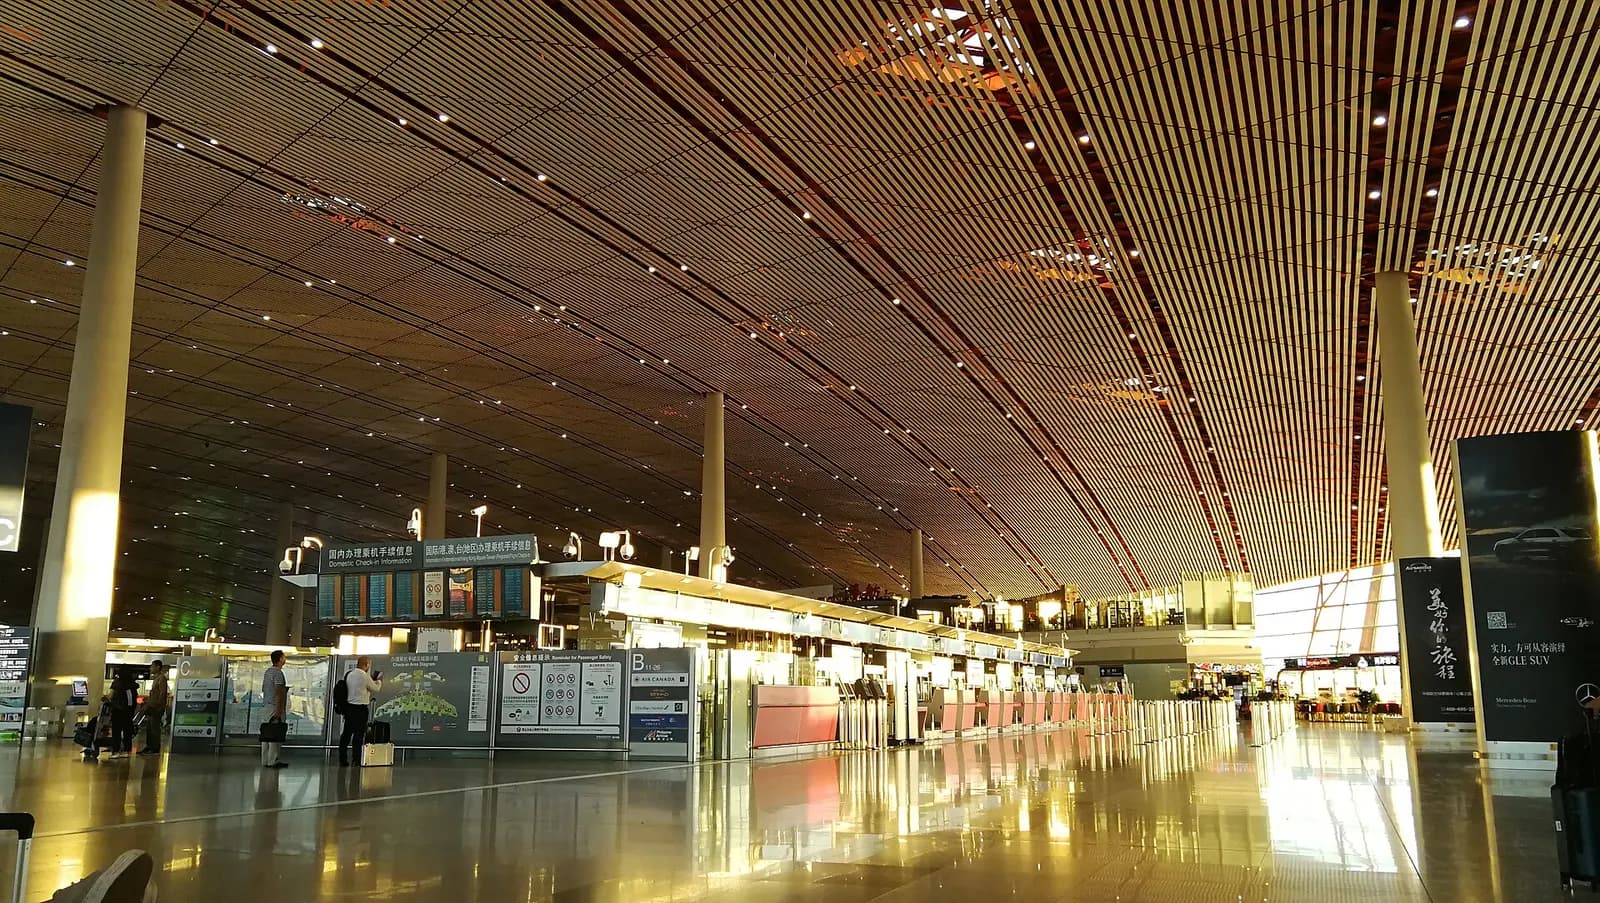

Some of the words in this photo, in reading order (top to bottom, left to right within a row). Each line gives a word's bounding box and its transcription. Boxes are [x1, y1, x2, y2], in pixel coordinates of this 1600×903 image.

[328, 545, 413, 560] 国内办理乘机手续信息
[328, 560, 354, 568] Domestic
[355, 558, 380, 567] Check-in
[381, 557, 412, 566] Information
[632, 653, 645, 671] B
[1529, 655, 1550, 665] SUV
[180, 660, 191, 676] C
